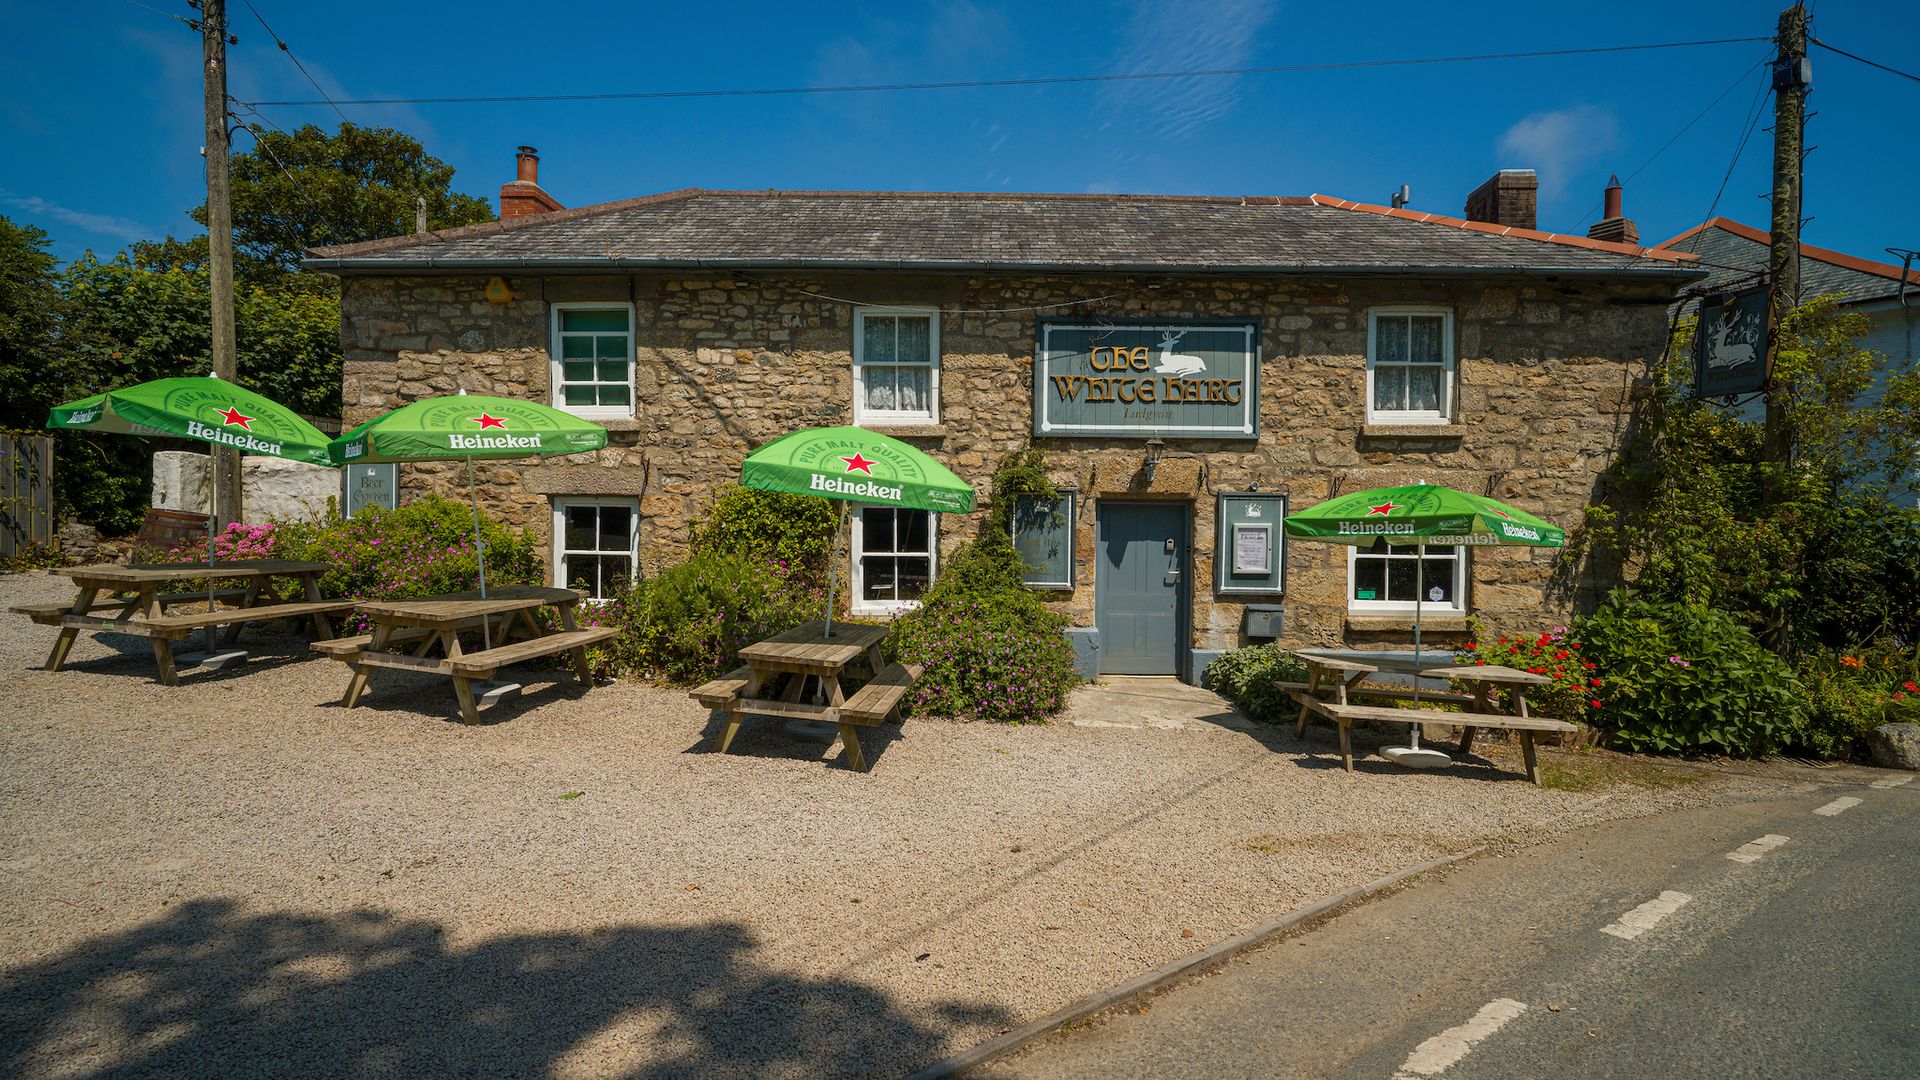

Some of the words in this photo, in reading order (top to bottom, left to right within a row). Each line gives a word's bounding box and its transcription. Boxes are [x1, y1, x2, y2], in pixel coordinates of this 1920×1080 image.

[1051, 375, 1158, 402] WHITE
[1162, 375, 1243, 404] HART
[174, 391, 196, 411] PURE
[197, 390, 237, 405] MALT
[244, 402, 299, 439] QUALITY
[430, 410, 450, 427] PURE
[450, 404, 485, 414] MALT
[494, 405, 550, 428] QUALITY
[185, 420, 282, 456] Heineken
[448, 433, 542, 449] Heineken
[799, 443, 824, 464] PURE
[826, 439, 865, 451] MALT
[871, 443, 918, 480] QUALITY
[360, 477, 384, 489] Beer
[809, 473, 903, 501] Heineken
[1332, 499, 1364, 516] PURE
[1367, 492, 1405, 503] MALT
[1338, 519, 1416, 535] Heineken
[1501, 521, 1541, 542] Heineken
